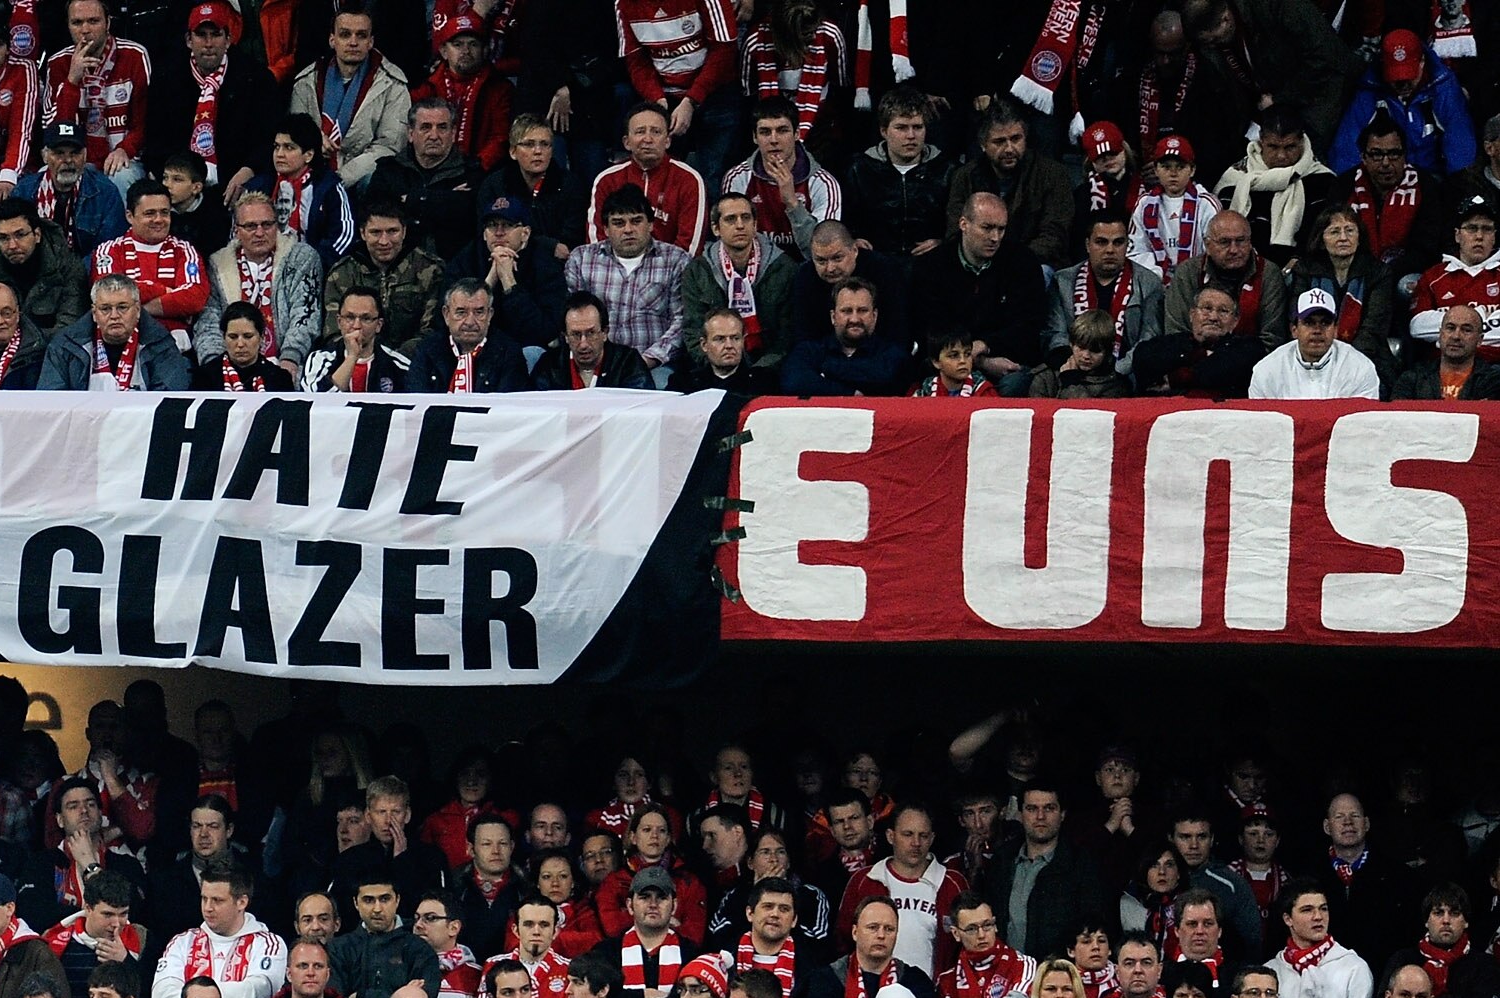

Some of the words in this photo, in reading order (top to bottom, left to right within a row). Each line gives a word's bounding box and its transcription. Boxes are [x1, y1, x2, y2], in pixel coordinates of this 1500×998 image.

[141, 397, 490, 516] HATE
[962, 408, 1480, 634] UNS
[17, 525, 539, 672] GLAZER
